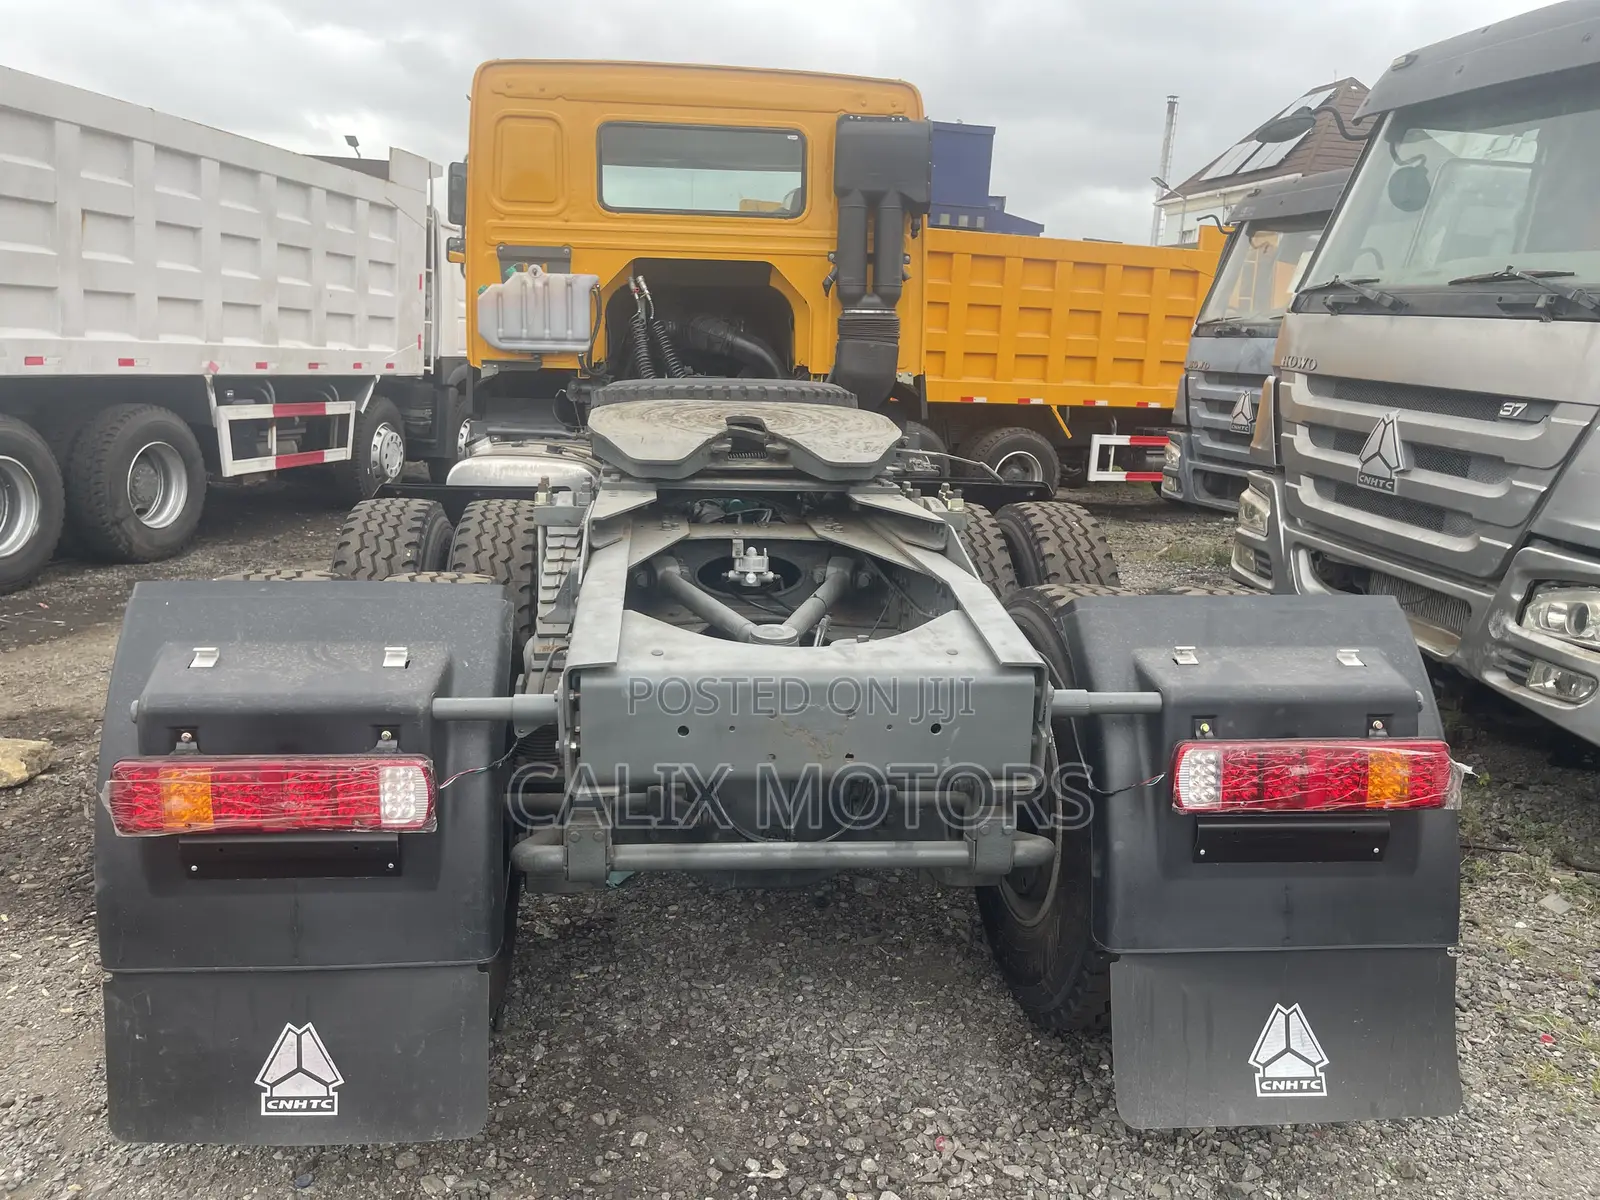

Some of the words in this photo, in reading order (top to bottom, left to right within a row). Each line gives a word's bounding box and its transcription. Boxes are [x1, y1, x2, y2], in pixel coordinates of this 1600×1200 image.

[1280, 355, 1318, 371] HOWO
[1358, 474, 1395, 490] CNHTC
[1260, 1079, 1322, 1091] CNHTC
[266, 1099, 334, 1110] CNHTC
